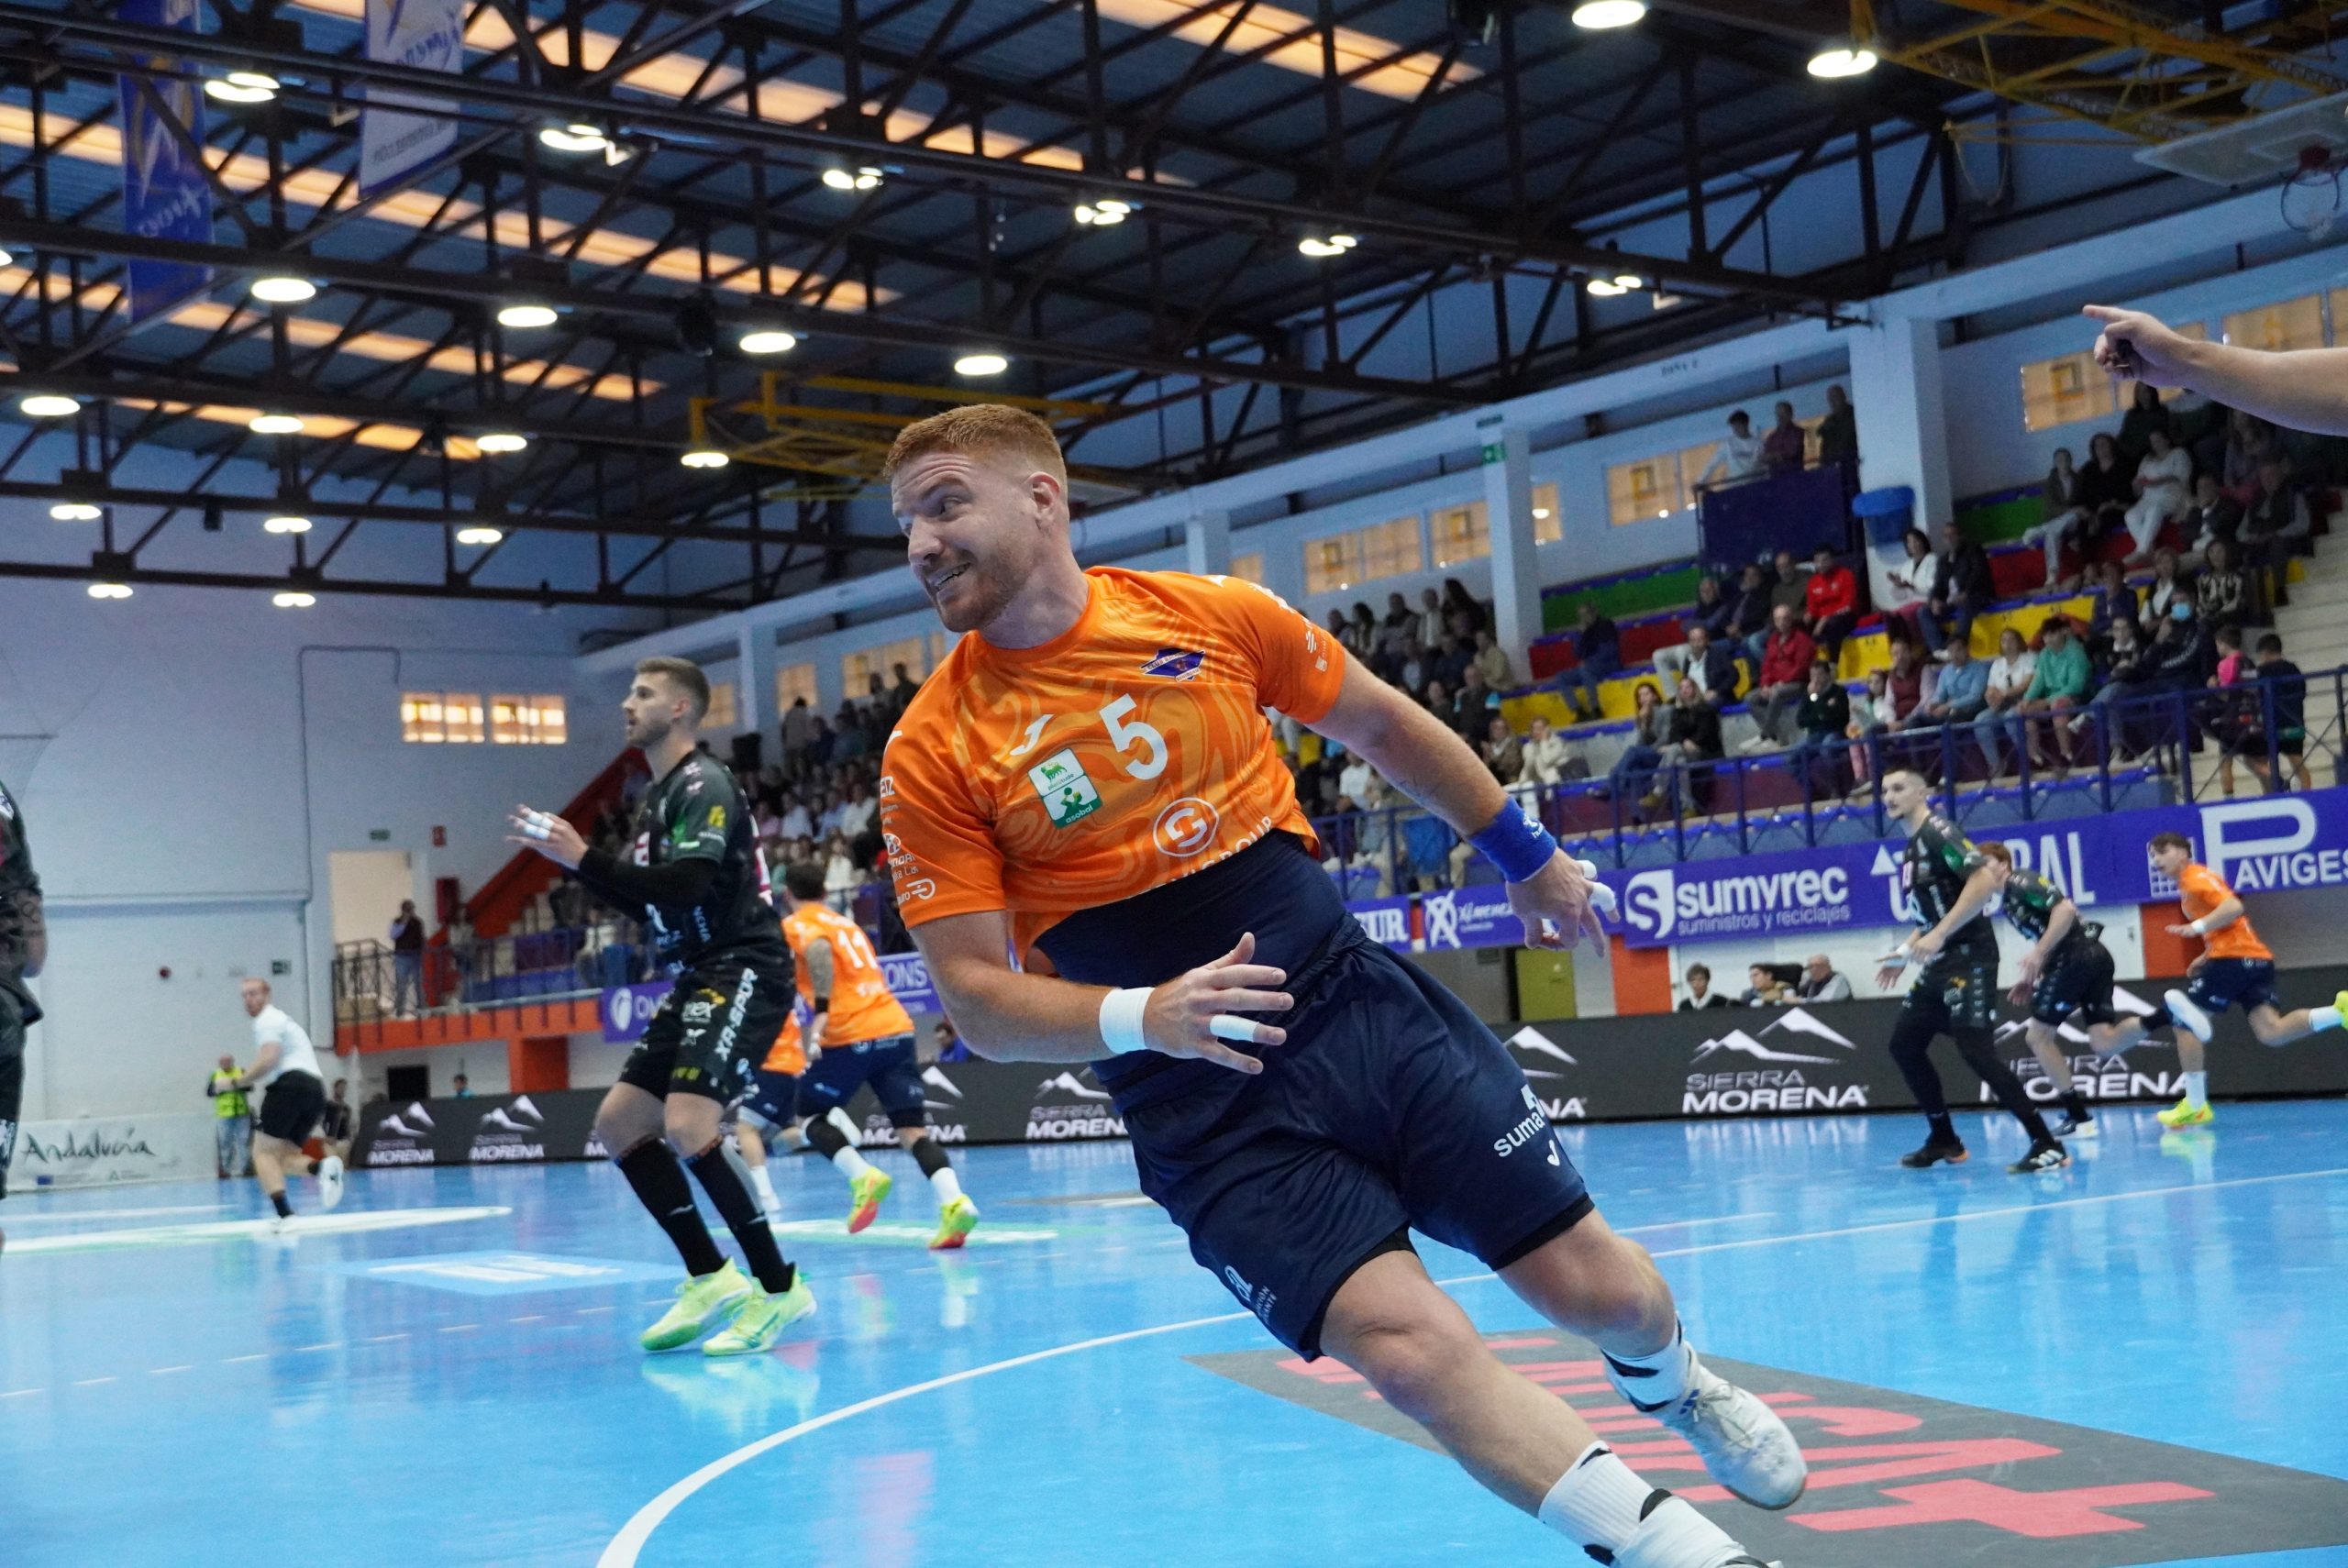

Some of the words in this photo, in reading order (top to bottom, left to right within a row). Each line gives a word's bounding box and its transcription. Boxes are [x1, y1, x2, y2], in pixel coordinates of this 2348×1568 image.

[1100, 694, 1168, 780] 5
[1065, 803, 1094, 823] asobal
[1676, 867, 1849, 919] sumyrec
[1678, 911, 1759, 936] suministros
[1763, 911, 1776, 933] y
[1776, 903, 1852, 926] reciclajes
[836, 929, 879, 969] 11
[1685, 1068, 1806, 1091] SIERRA
[1029, 1103, 1107, 1121] SIERRA
[1681, 1085, 1867, 1114] MORENA
[1025, 1117, 1129, 1139] MOREN
[1493, 1110, 1545, 1157] suma
[368, 1148, 436, 1165] MORENA
[469, 1143, 545, 1161] MORENA
